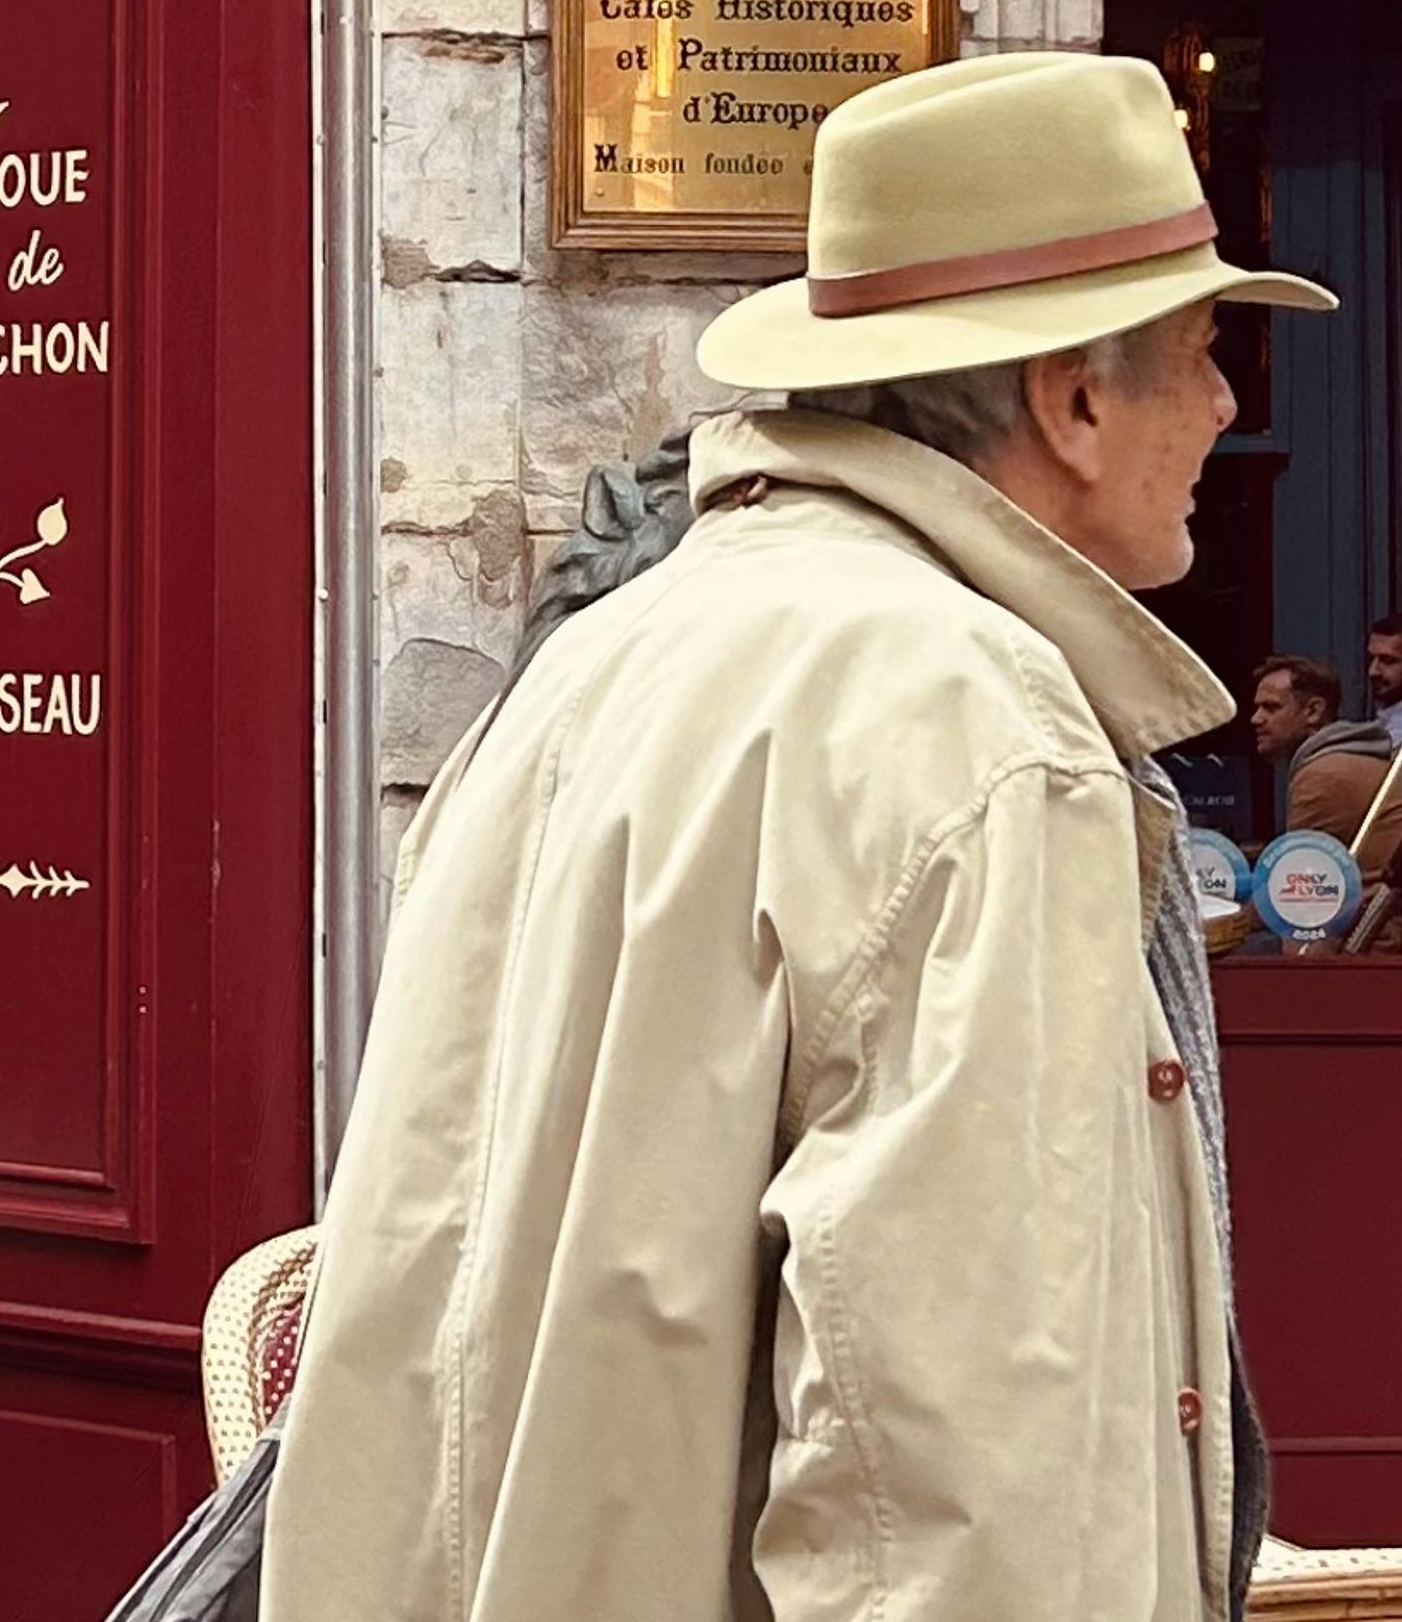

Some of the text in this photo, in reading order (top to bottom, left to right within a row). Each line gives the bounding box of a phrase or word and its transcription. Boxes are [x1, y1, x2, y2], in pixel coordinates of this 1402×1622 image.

[615, 38, 902, 73] et Patrimoniaux
[594, 143, 685, 175] Maison
[8, 229, 64, 291] de
